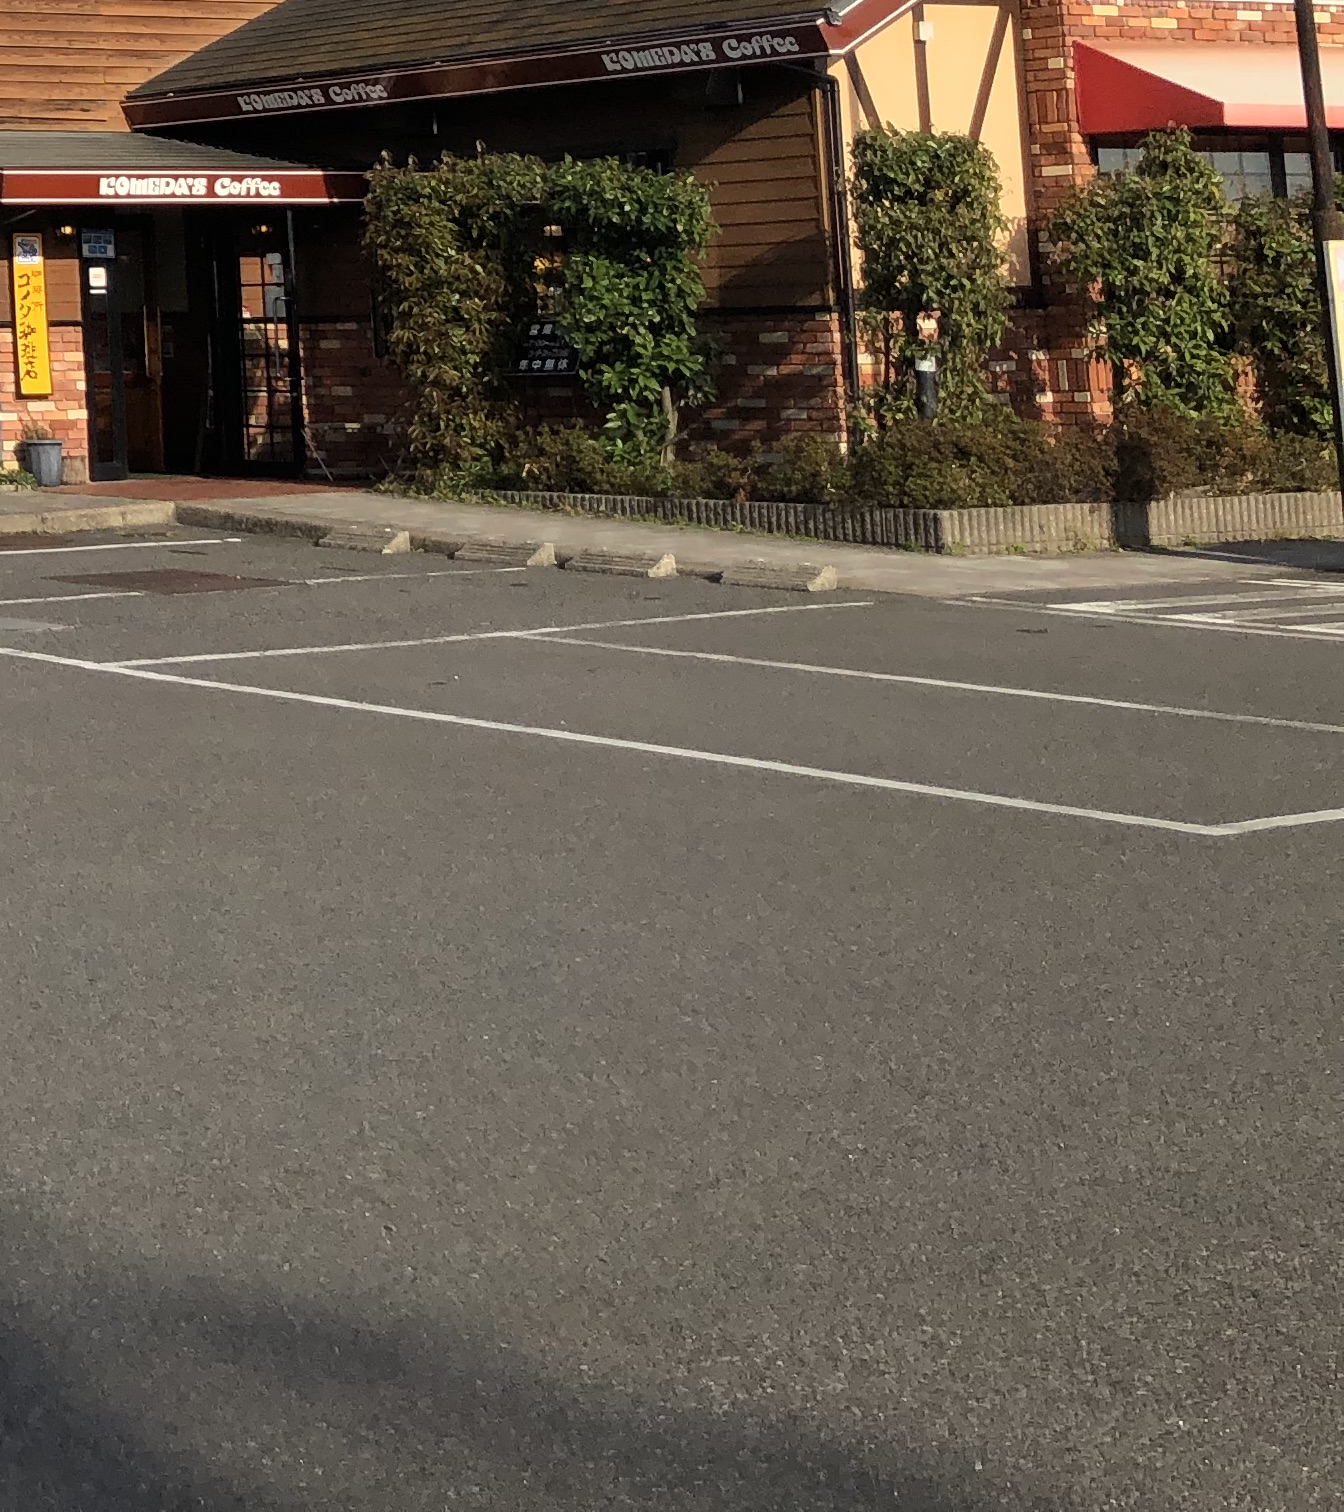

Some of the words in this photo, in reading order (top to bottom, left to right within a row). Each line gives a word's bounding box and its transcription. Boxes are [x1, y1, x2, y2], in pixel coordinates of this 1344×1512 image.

[600, 42, 717, 72] KOMEDA'S
[721, 34, 800, 59] Coffee
[236, 88, 326, 112] KOMEDA'S
[328, 82, 388, 104] Coffee
[99, 176, 207, 196] KOMEDA'S
[213, 177, 281, 197] Coffee
